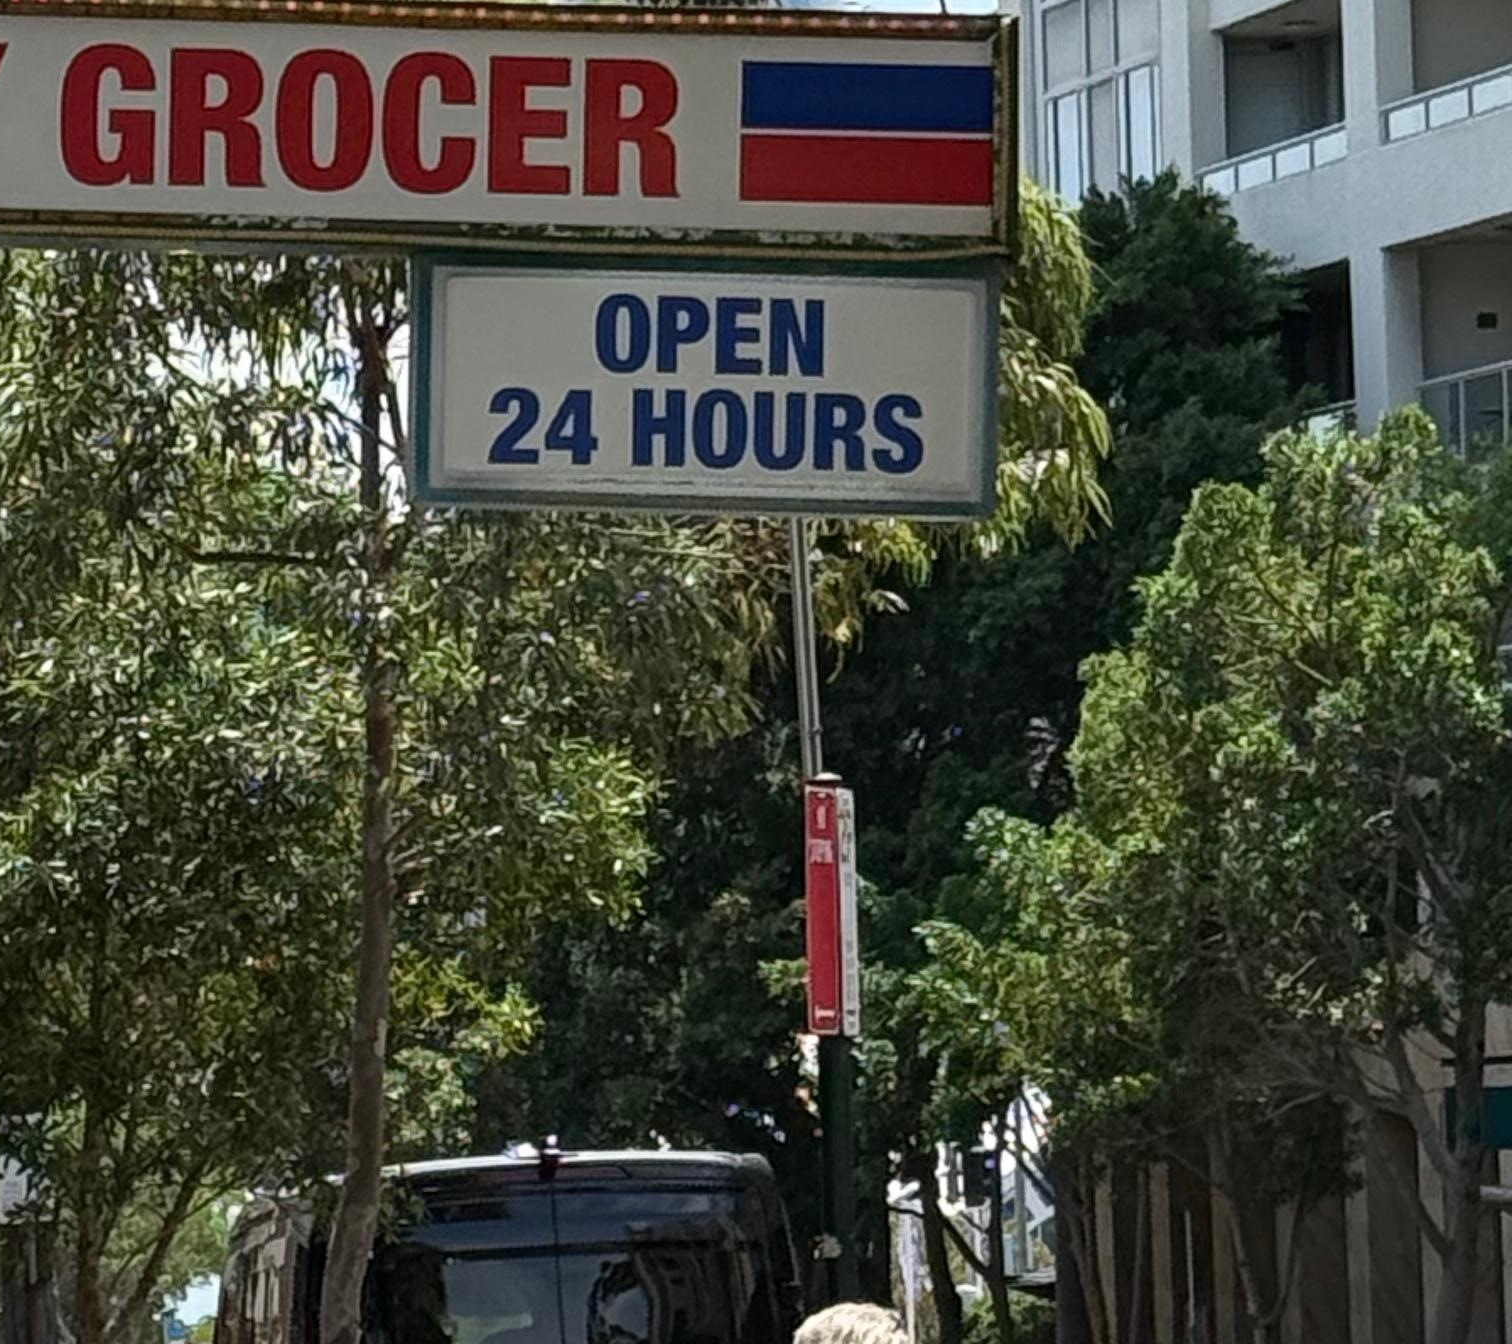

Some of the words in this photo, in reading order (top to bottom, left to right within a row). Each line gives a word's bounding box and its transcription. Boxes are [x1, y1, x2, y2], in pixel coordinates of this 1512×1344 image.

[59, 42, 681, 200] GROCER
[595, 293, 825, 378] OPEN
[488, 387, 598, 466] 24
[631, 388, 925, 474] HOURS
